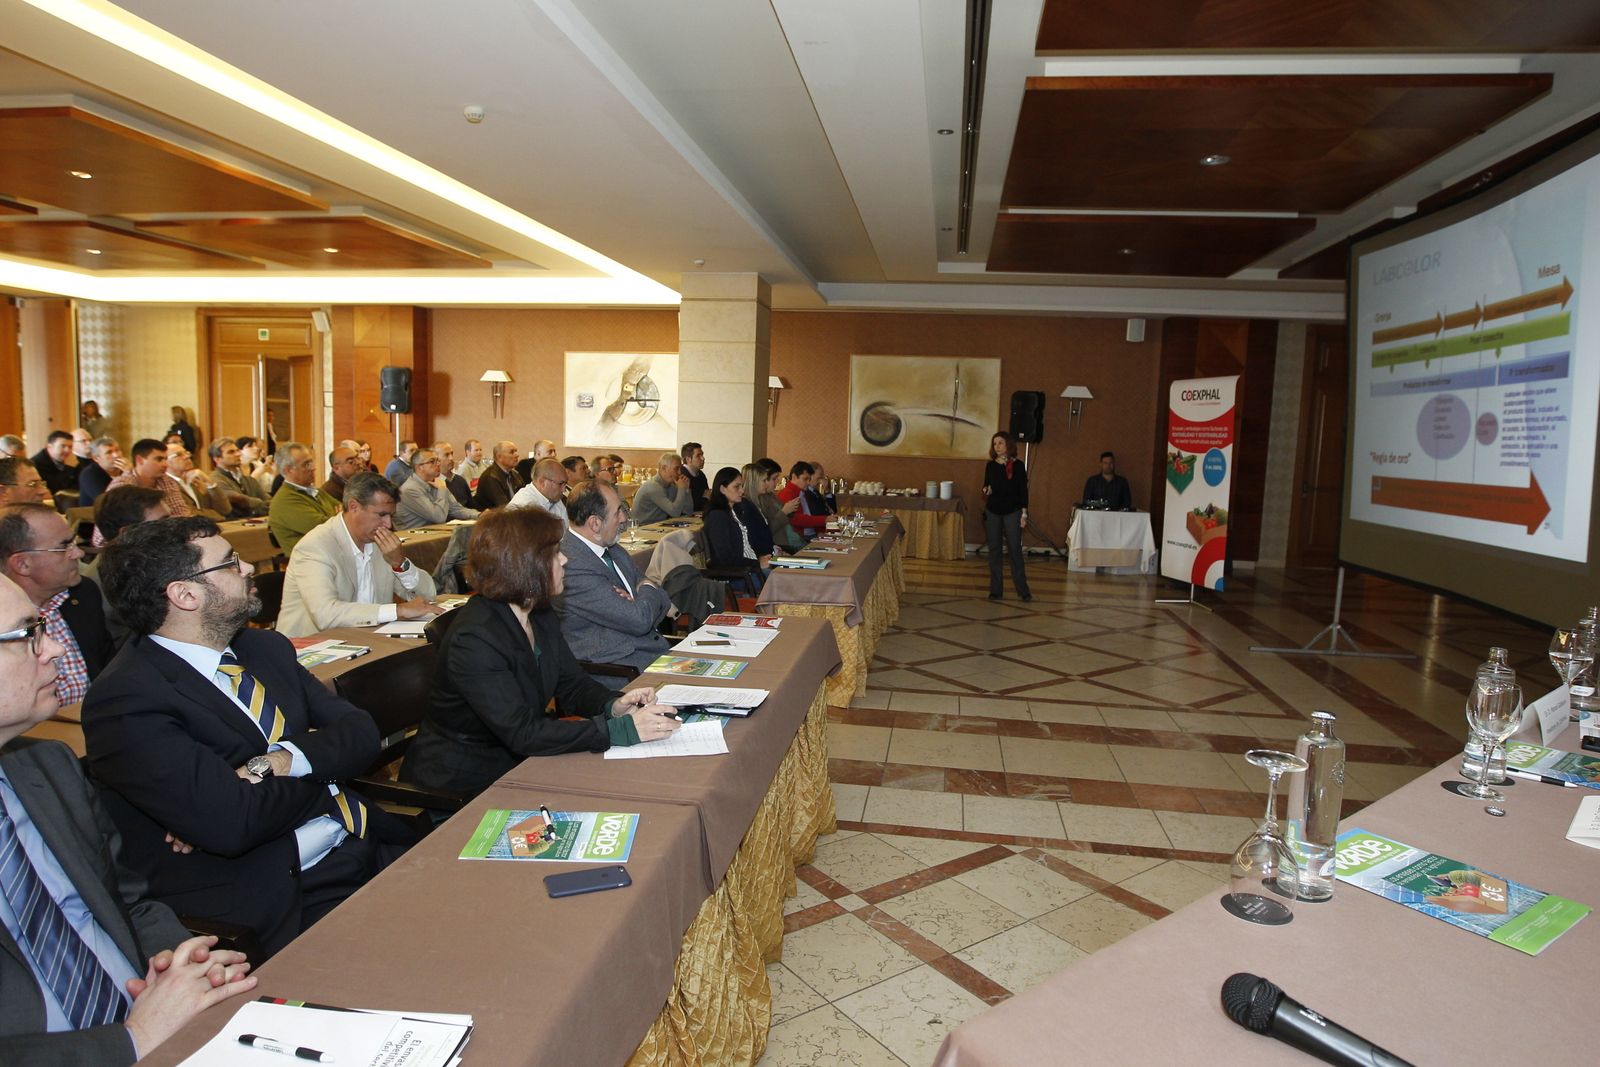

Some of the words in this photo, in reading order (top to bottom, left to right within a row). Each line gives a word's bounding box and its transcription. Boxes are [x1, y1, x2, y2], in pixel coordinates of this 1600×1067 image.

[1373, 251, 1441, 286] LABCOLOR
[1181, 388, 1221, 401] COEXPHAL
[381, 1041, 394, 1052] del
